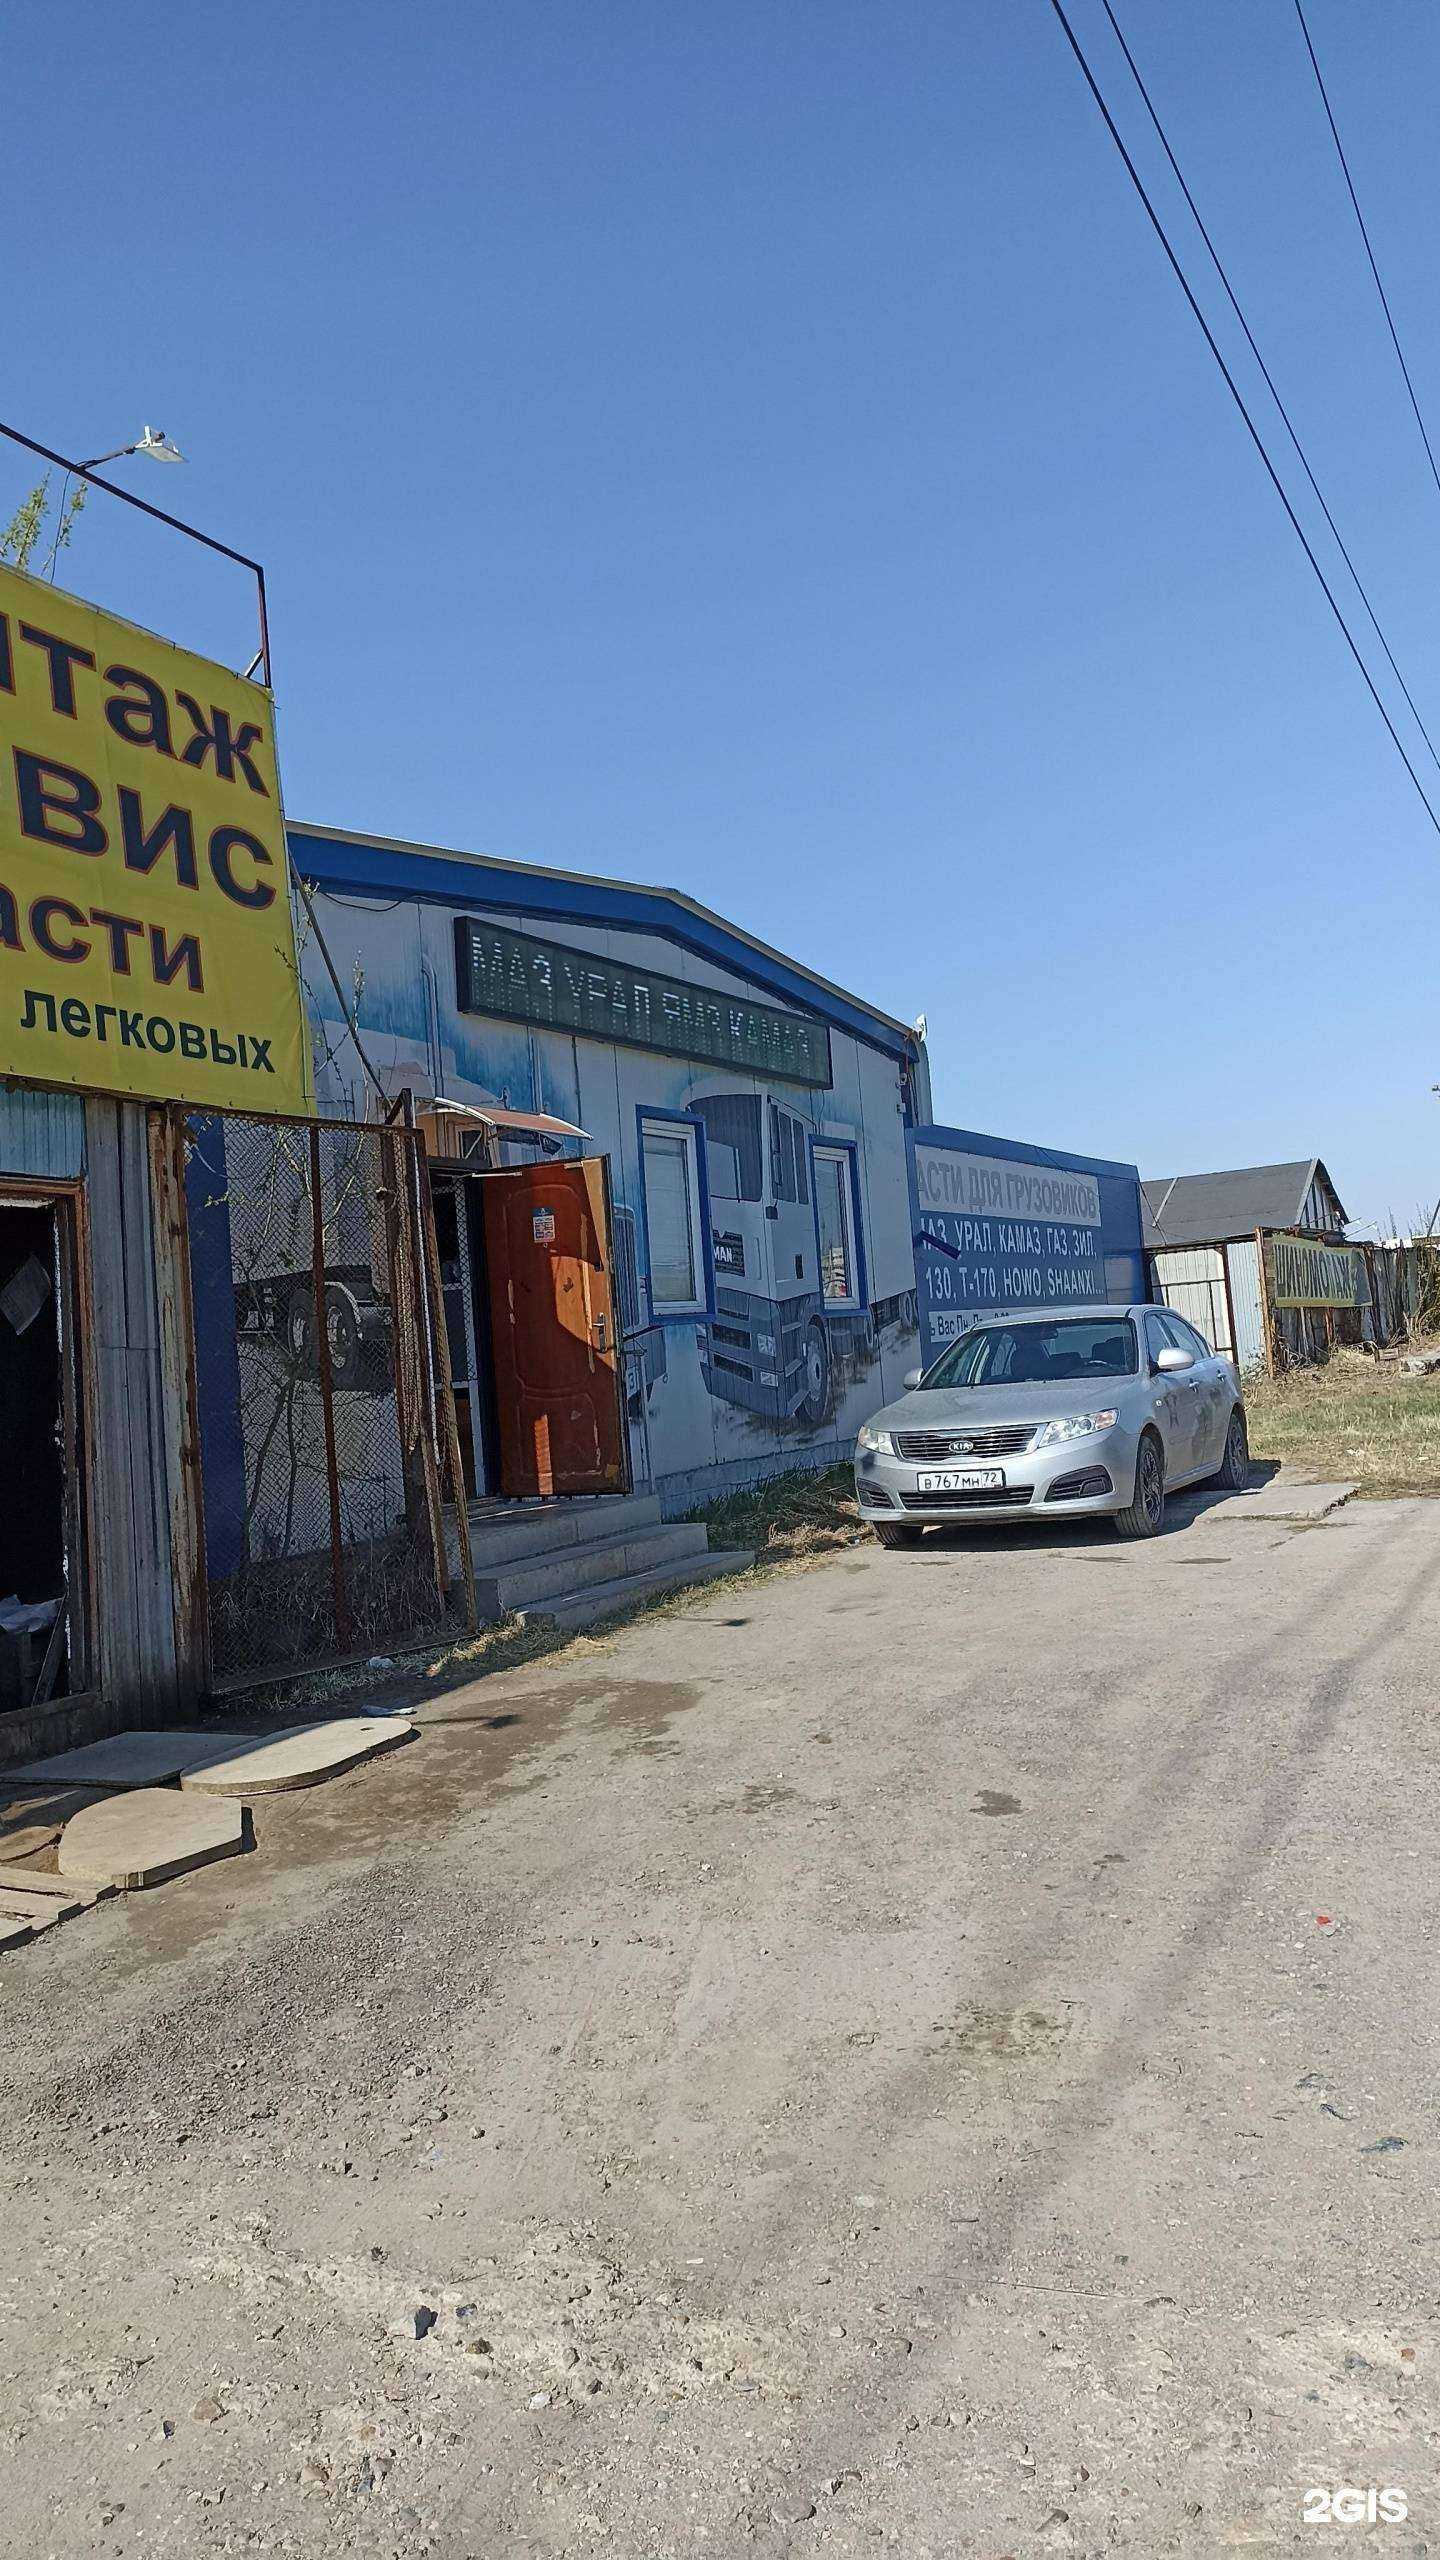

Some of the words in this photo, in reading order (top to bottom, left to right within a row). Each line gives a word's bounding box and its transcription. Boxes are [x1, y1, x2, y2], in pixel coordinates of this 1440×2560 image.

[0, 611, 270, 798] таж
[20, 989, 276, 1074] легковых
[967, 1166, 1004, 1213] ДЛЯ
[1005, 1172, 1098, 1219] ГРУЗОВИКОВ
[954, 1219, 997, 1257] УРАЛ,
[999, 1224, 1045, 1259] КАМАЗ,
[1047, 1227, 1073, 1260] ГАЗ,
[1073, 1229, 1098, 1260] ЗИЛ,
[958, 1266, 1002, 1301] Т-170,
[1003, 1267, 1047, 1300] HOWO,
[938, 1315, 955, 1336] Вас
[953, 1442, 971, 1450] KIA
